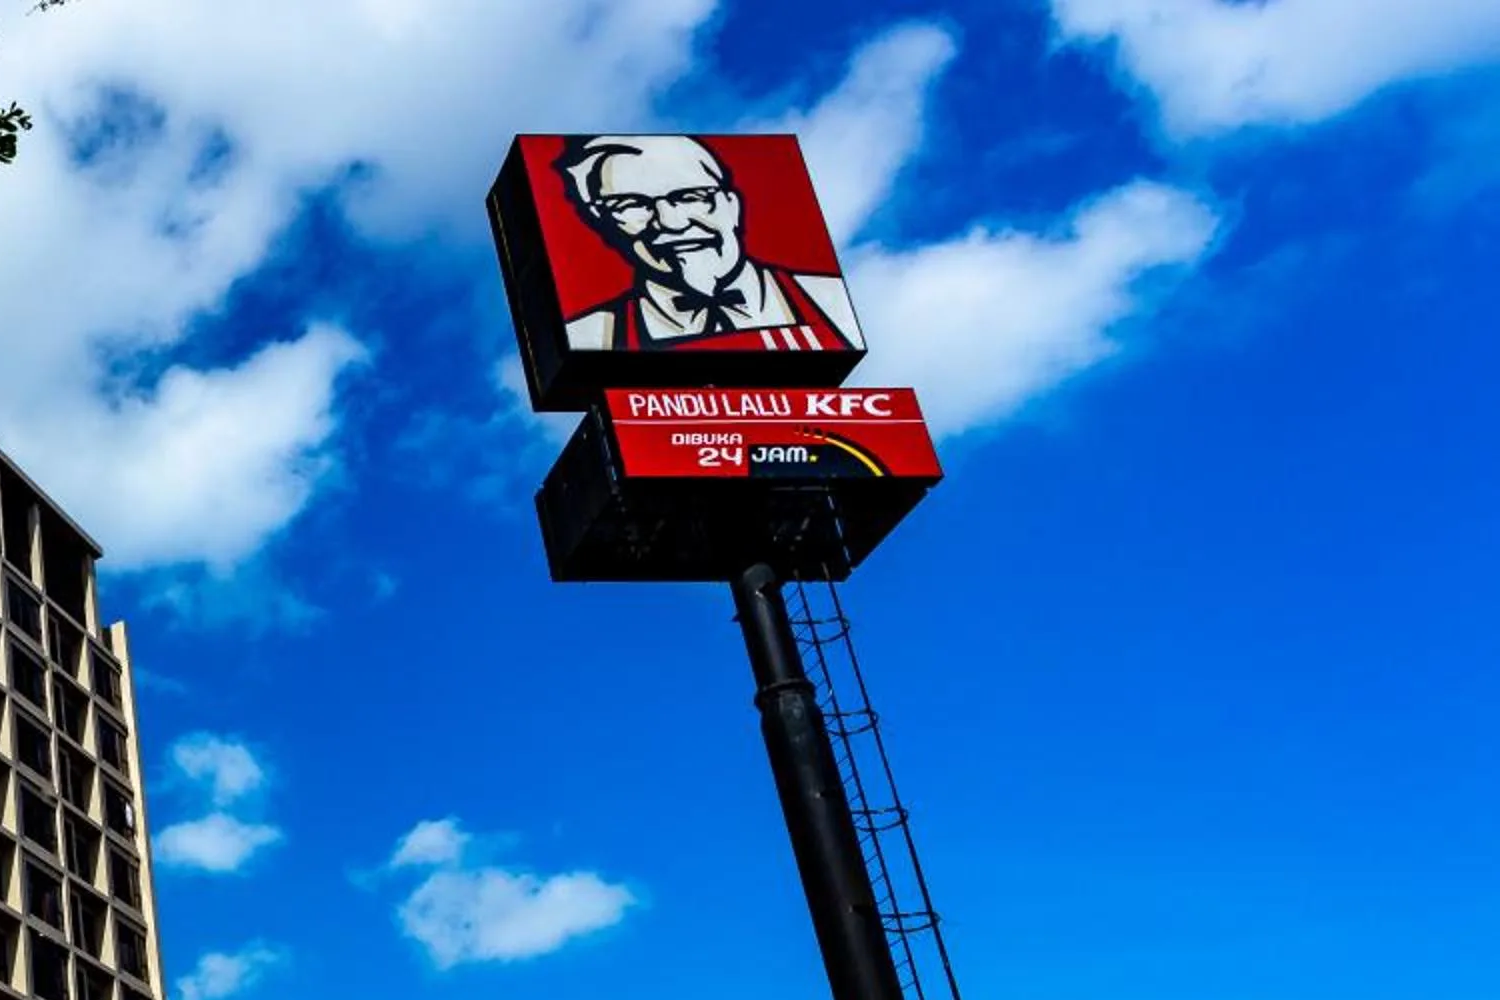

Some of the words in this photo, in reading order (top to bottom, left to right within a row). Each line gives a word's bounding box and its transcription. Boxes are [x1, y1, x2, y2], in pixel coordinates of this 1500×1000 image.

[627, 393, 719, 417] PANDU
[725, 393, 791, 417] LALU
[805, 393, 892, 417] KFC
[670, 432, 743, 446] DIBUKA
[697, 447, 742, 467] 24
